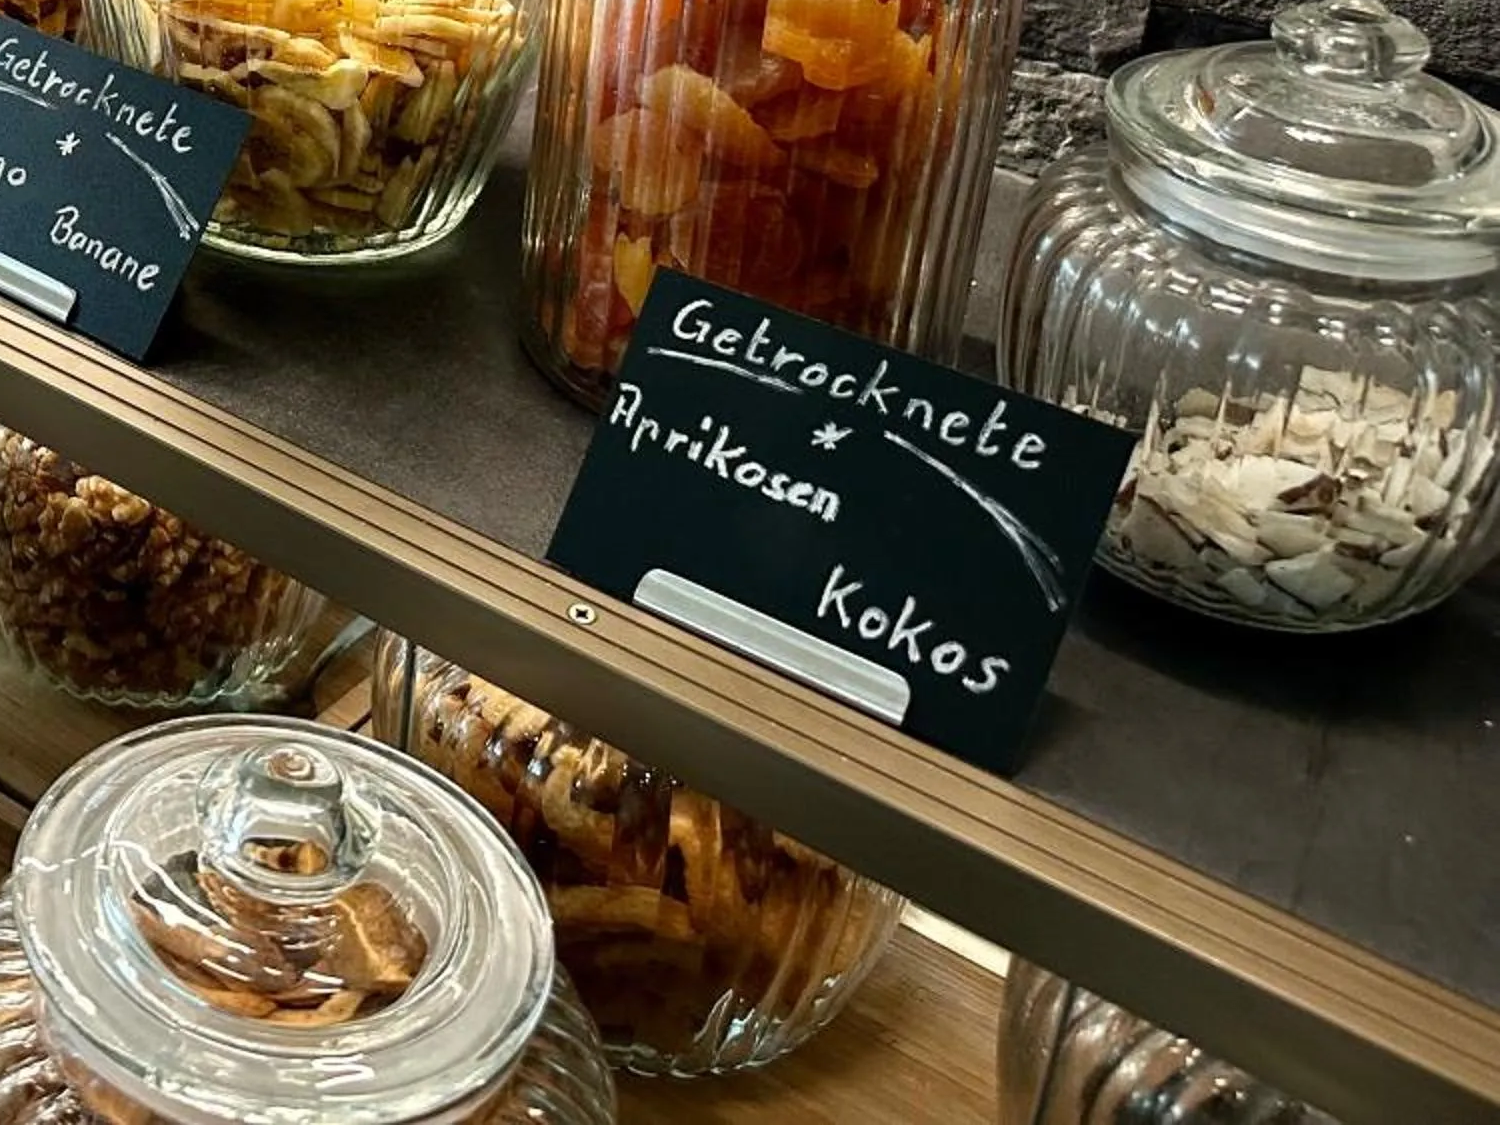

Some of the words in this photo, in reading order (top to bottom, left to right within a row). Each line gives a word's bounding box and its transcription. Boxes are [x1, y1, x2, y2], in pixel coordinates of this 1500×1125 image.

[49, 205, 160, 291] Banane
[671, 299, 1048, 470] Getrocknete
[609, 382, 841, 523] Aprikosen
[816, 564, 1012, 694] Kokos
